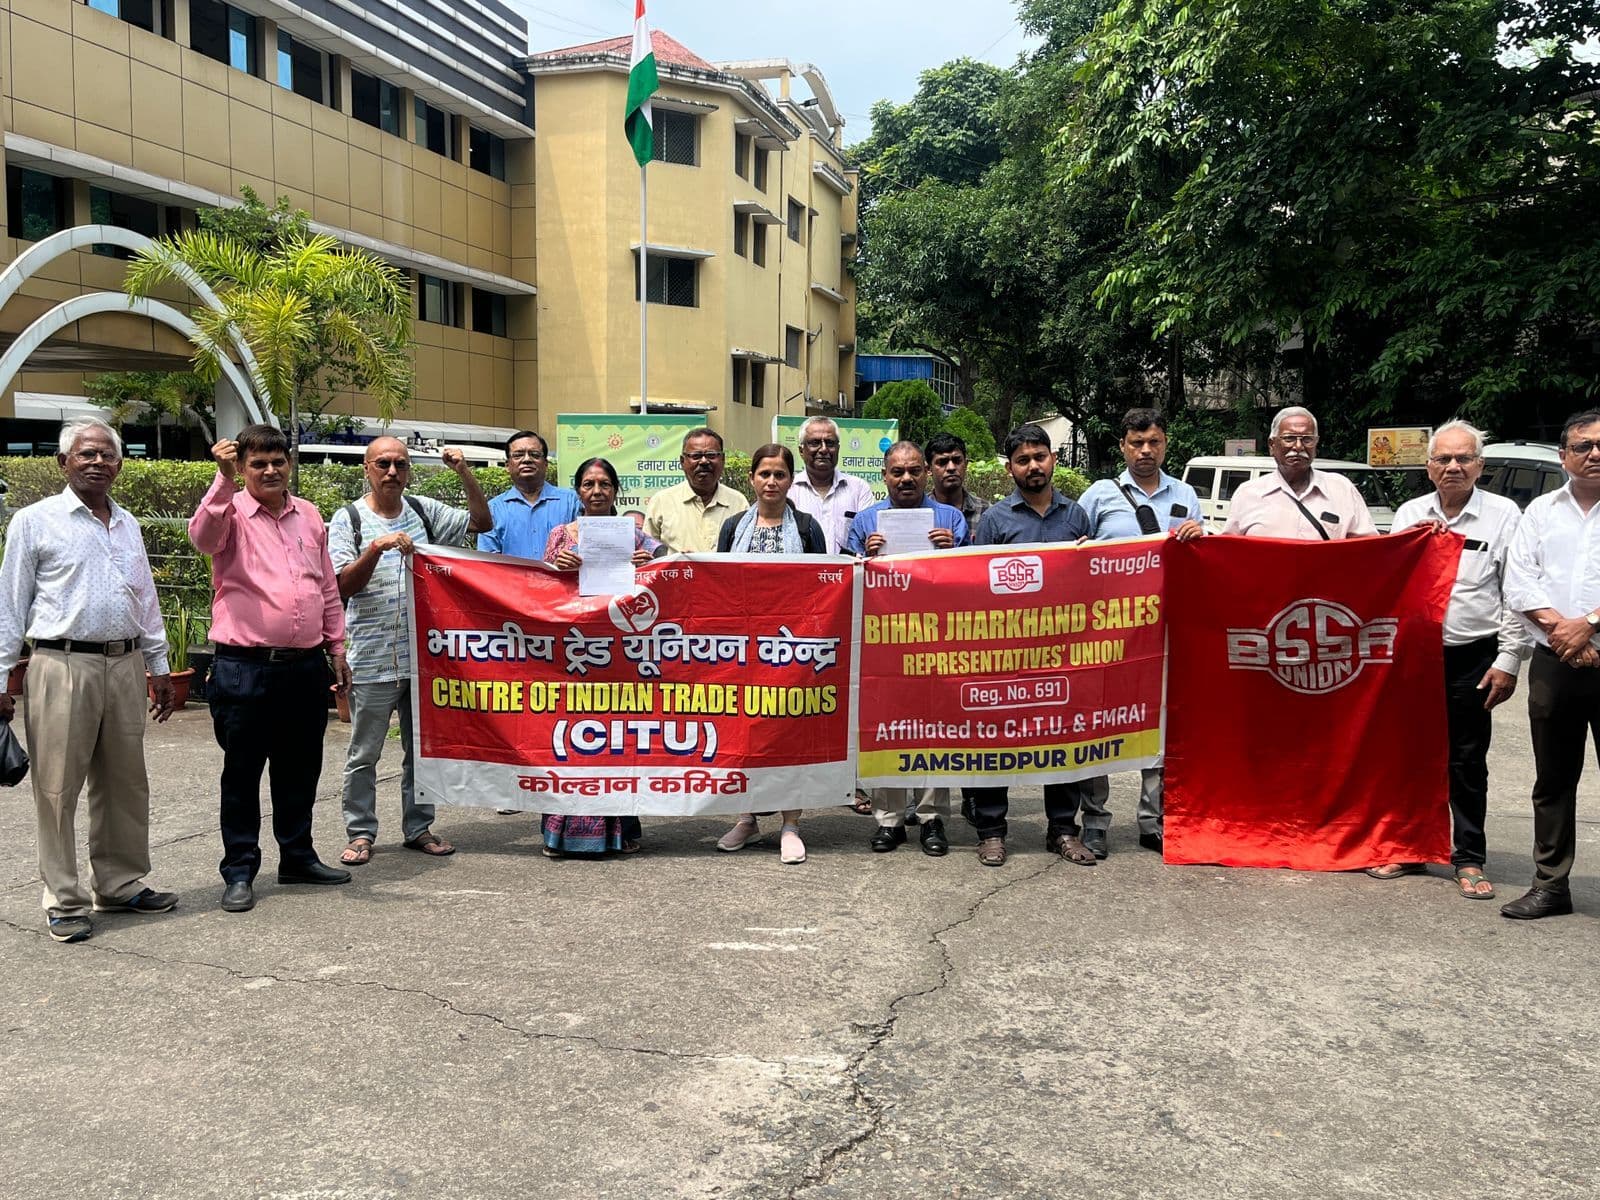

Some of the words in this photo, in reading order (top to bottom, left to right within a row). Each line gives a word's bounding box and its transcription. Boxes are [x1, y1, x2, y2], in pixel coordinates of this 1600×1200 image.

[637, 460, 666, 471] हमारा
[842, 456, 865, 467] हमारा
[635, 570, 657, 584] जदूर
[660, 569, 679, 580] एक
[682, 565, 694, 580] हो
[817, 568, 843, 584] संघर्ष
[1090, 550, 1161, 577] Struggle
[865, 570, 912, 591] Unity
[864, 612, 939, 644] BIHAR
[944, 603, 1087, 642] JHARKHAND
[1092, 594, 1161, 631] SALES
[427, 621, 555, 662] भारतीय
[563, 627, 614, 675] ट्रेड
[621, 621, 749, 677] यूनियन
[757, 625, 840, 674] केन्द्र
[903, 645, 1066, 676] REPRESENTATIVES'
[1069, 639, 1125, 667] UNION
[1278, 659, 1353, 689] UNION
[432, 677, 524, 713] CENTRE
[529, 681, 560, 713] OF
[566, 680, 653, 714] INDIAN
[659, 682, 738, 714] TRADE
[744, 684, 837, 717] UNIONS
[970, 686, 1003, 705] Reg.
[1007, 685, 1031, 701] No.
[1035, 681, 1062, 699] 691
[876, 719, 971, 742] Affiliated
[977, 721, 998, 740] to
[1003, 715, 1067, 738] C.I.T.U.
[1073, 713, 1086, 733] &
[1092, 703, 1147, 730] FMRAI
[552, 718, 718, 762] (CITU)
[898, 749, 1067, 772] JAMSHEDPUR
[1073, 739, 1125, 765] UNIT
[517, 770, 641, 796] कोल्हान
[648, 769, 750, 795] कमिटी
